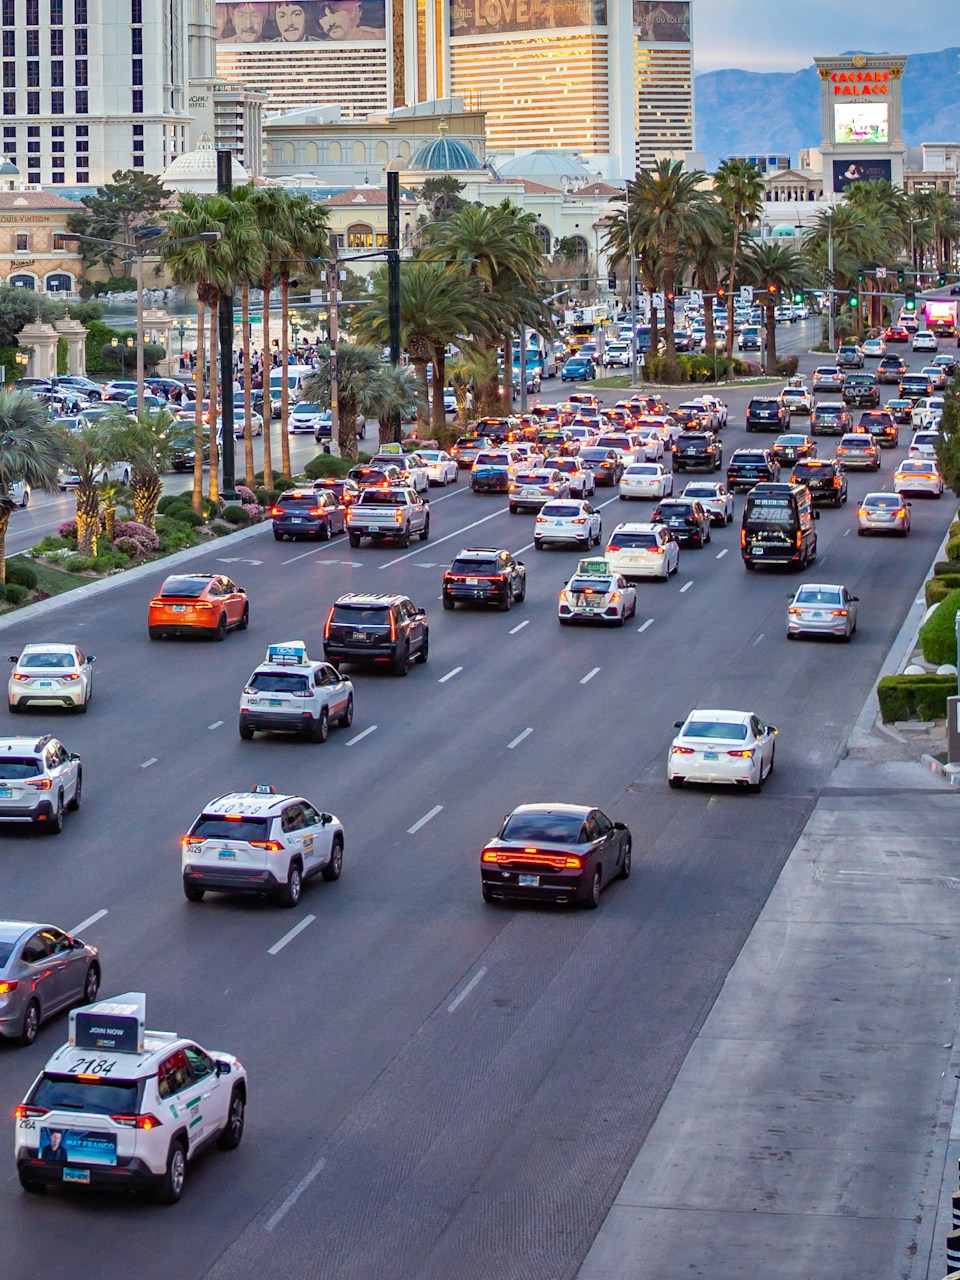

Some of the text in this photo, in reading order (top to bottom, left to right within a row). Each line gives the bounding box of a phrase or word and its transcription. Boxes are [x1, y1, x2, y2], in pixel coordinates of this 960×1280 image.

[831, 71, 890, 82] CAESARS
[834, 84, 888, 95] PALACE
[186, 845, 202, 854] 3029
[107, 1028, 124, 1036] NOW
[67, 1058, 117, 1075] 2184
[19, 1118, 36, 1130] 2184
[82, 1140, 115, 1150] FRANCO
